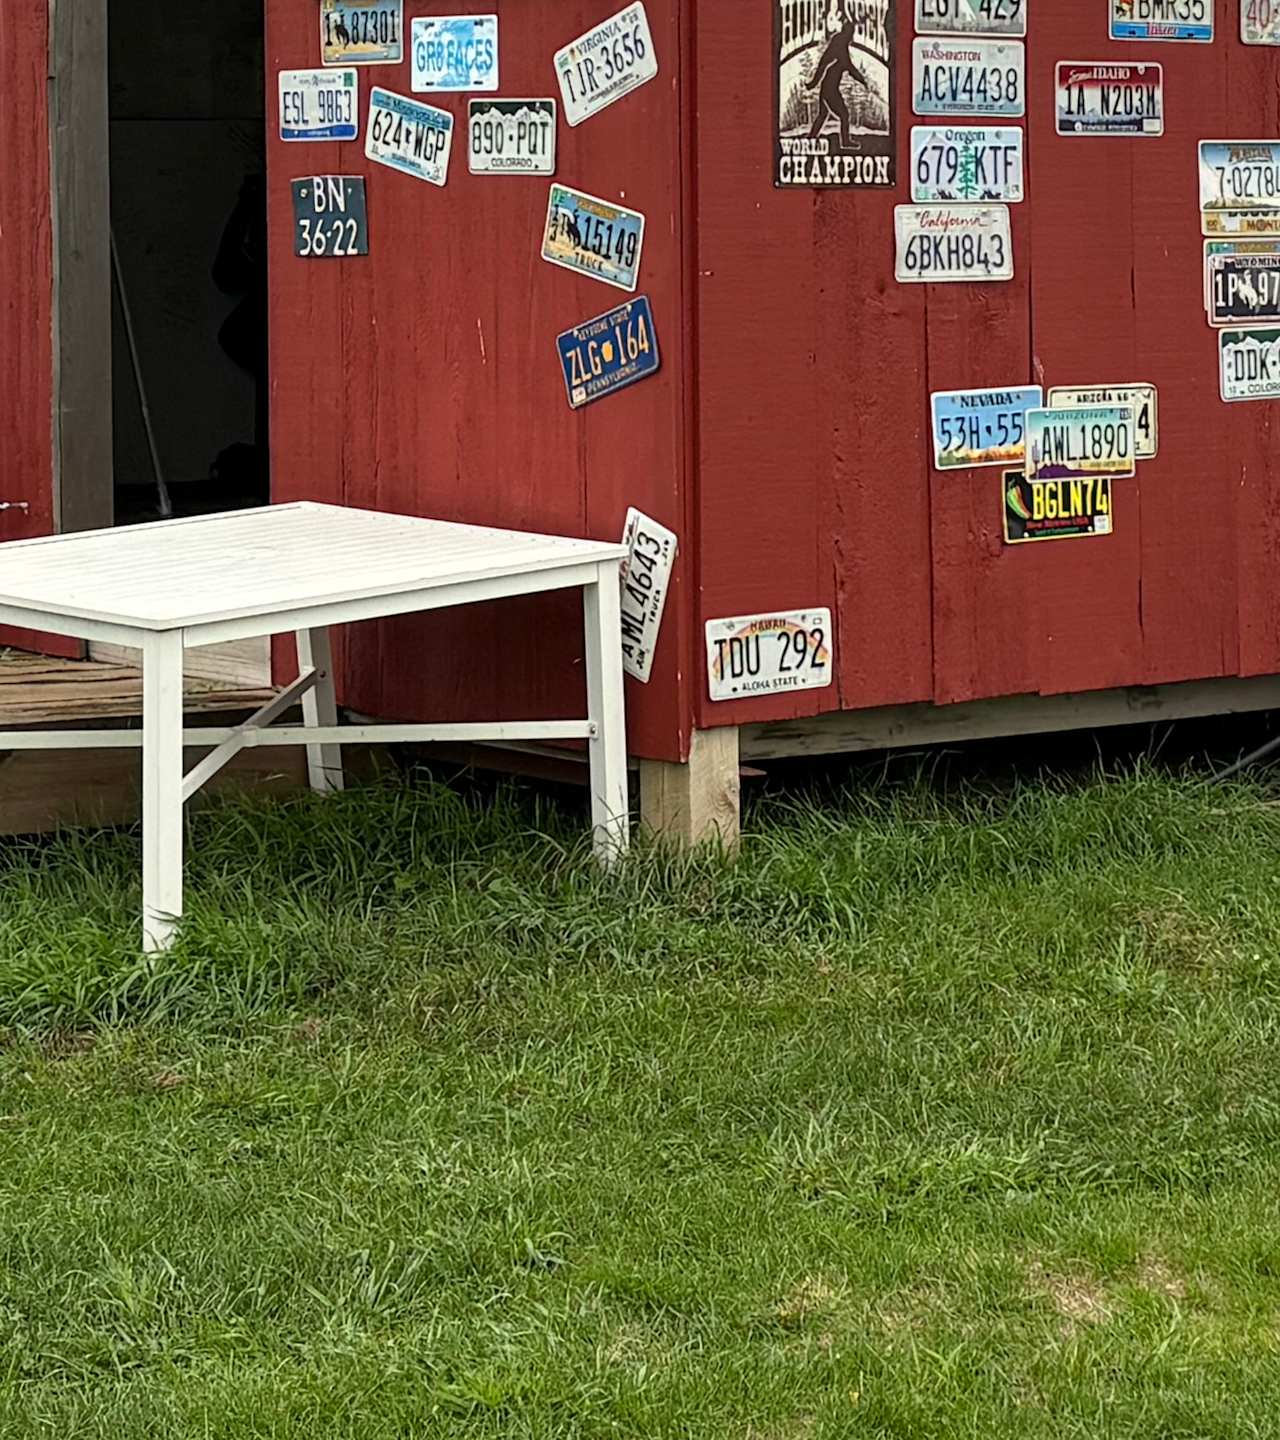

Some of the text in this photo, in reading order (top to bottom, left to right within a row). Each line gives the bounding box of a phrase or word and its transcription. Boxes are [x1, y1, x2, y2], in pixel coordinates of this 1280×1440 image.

[351, 9, 398, 45] 87301
[576, 21, 622, 57] VIRGINIA
[921, 49, 982, 62] WASHINGTON
[921, 64, 1018, 103] ACV4438
[1092, 67, 1131, 80] IDAHO
[283, 90, 352, 124] ESL 9863
[1065, 84, 1086, 116] 1A
[372, 109, 404, 150] 624
[945, 128, 986, 145] Oregon
[491, 157, 533, 169] COLORADO
[779, 137, 830, 156] WORLD
[779, 156, 890, 185] CHAMPION
[917, 145, 1018, 186] 679 KTF
[313, 175, 345, 213] BN
[920, 210, 989, 228] California
[575, 251, 604, 272] TRUCK
[905, 234, 1005, 272] 6BKH843
[1215, 272, 1238, 308] 1P
[960, 393, 1013, 407] NEVADA
[1076, 393, 1113, 404] ARIZONA
[1138, 402, 1150, 439] 4
[1041, 423, 1128, 462] AWL1890
[1031, 478, 1108, 520] BGLN74
[750, 617, 787, 634] HAWAII
[714, 628, 825, 681] TDU 292
[741, 676, 799, 691] ALOHA STATE
